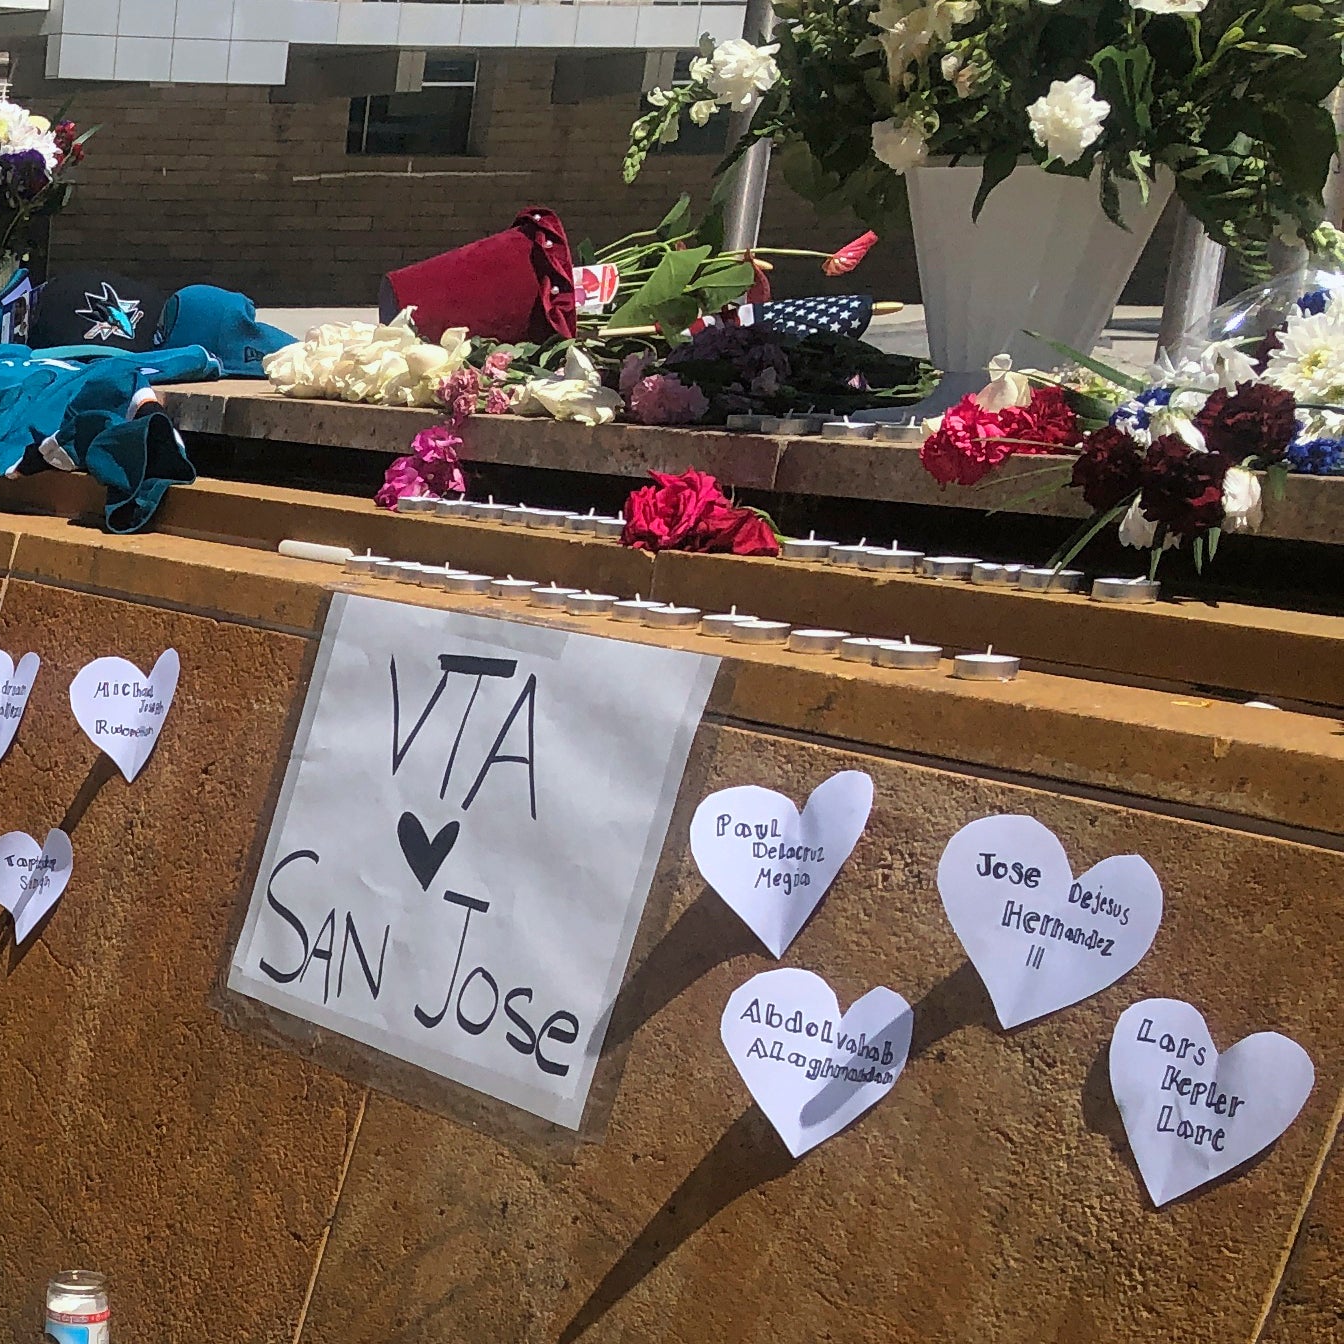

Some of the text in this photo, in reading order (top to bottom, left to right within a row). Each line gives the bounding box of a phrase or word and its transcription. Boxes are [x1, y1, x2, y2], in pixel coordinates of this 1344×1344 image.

[390, 654, 537, 821] VTA
[754, 867, 811, 895] Megia
[976, 852, 1042, 888] Jose
[259, 849, 391, 1005] SAN
[1001, 900, 1115, 956] Hernandez
[1068, 882, 1130, 926] Dejesus
[1137, 1018, 1206, 1066] Lars
[1161, 1064, 1245, 1118] Kepler
[1156, 1104, 1226, 1152] Lane
